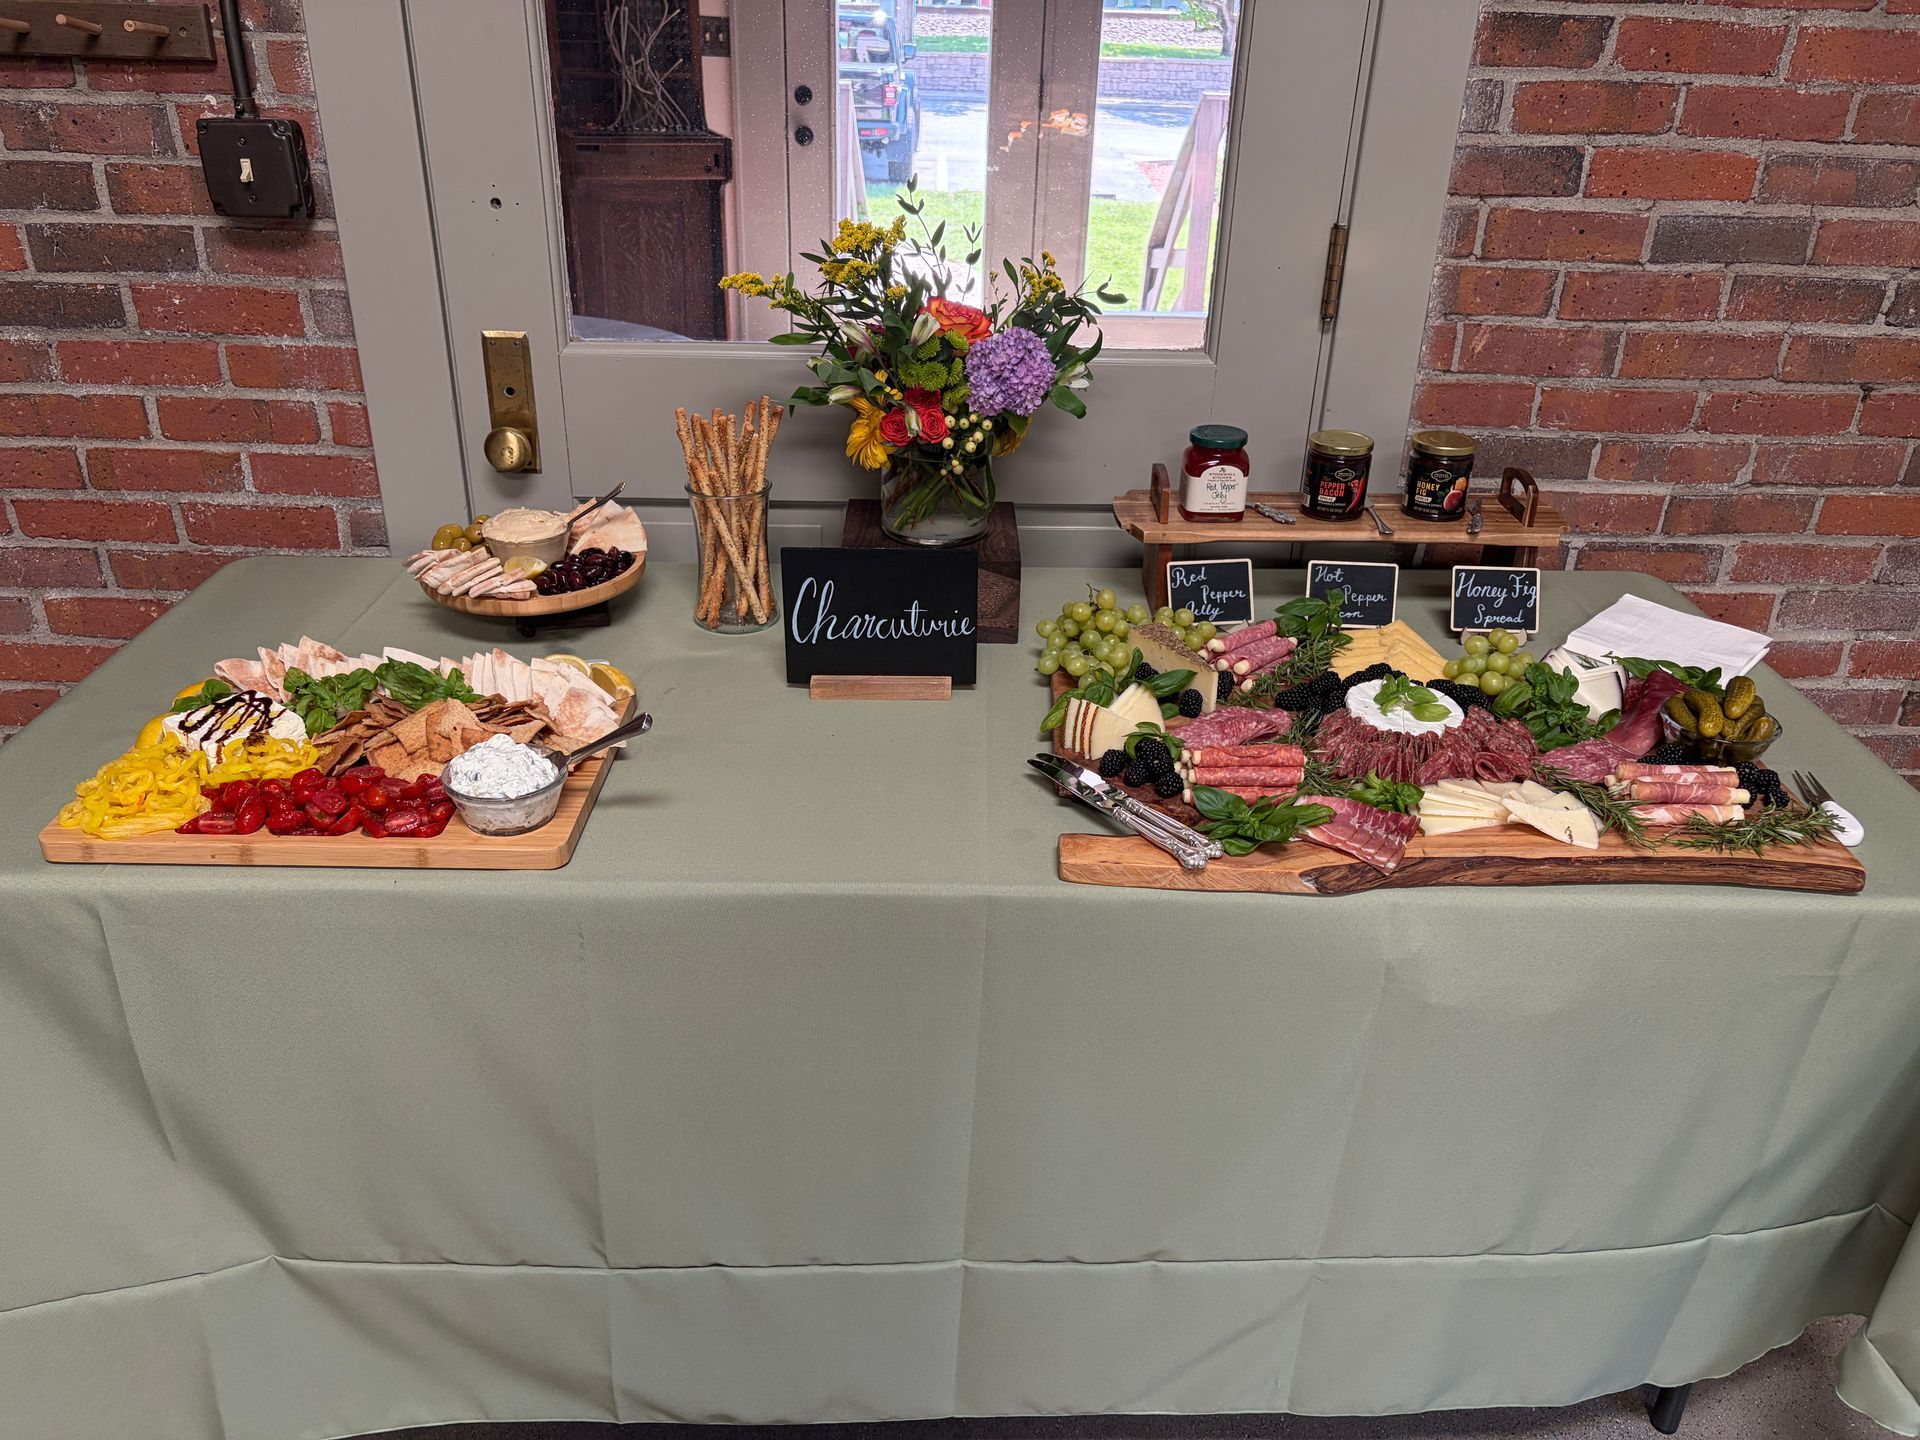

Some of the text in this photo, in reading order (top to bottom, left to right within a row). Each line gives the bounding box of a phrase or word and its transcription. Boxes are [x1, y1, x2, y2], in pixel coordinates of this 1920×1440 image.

[1206, 482, 1239, 493] Red Pepper
[1320, 480, 1345, 490] PEPPER
[1415, 488, 1427, 496] FIG
[1416, 480, 1440, 491] HONEY
[1211, 491, 1227, 504] Jelly
[1171, 566, 1207, 588] Red
[1315, 566, 1344, 582] Hot
[1201, 585, 1246, 604] Pepper
[1342, 584, 1387, 606] Pepper
[1455, 572, 1537, 608] Honey Fig
[1474, 604, 1525, 628] Spread
